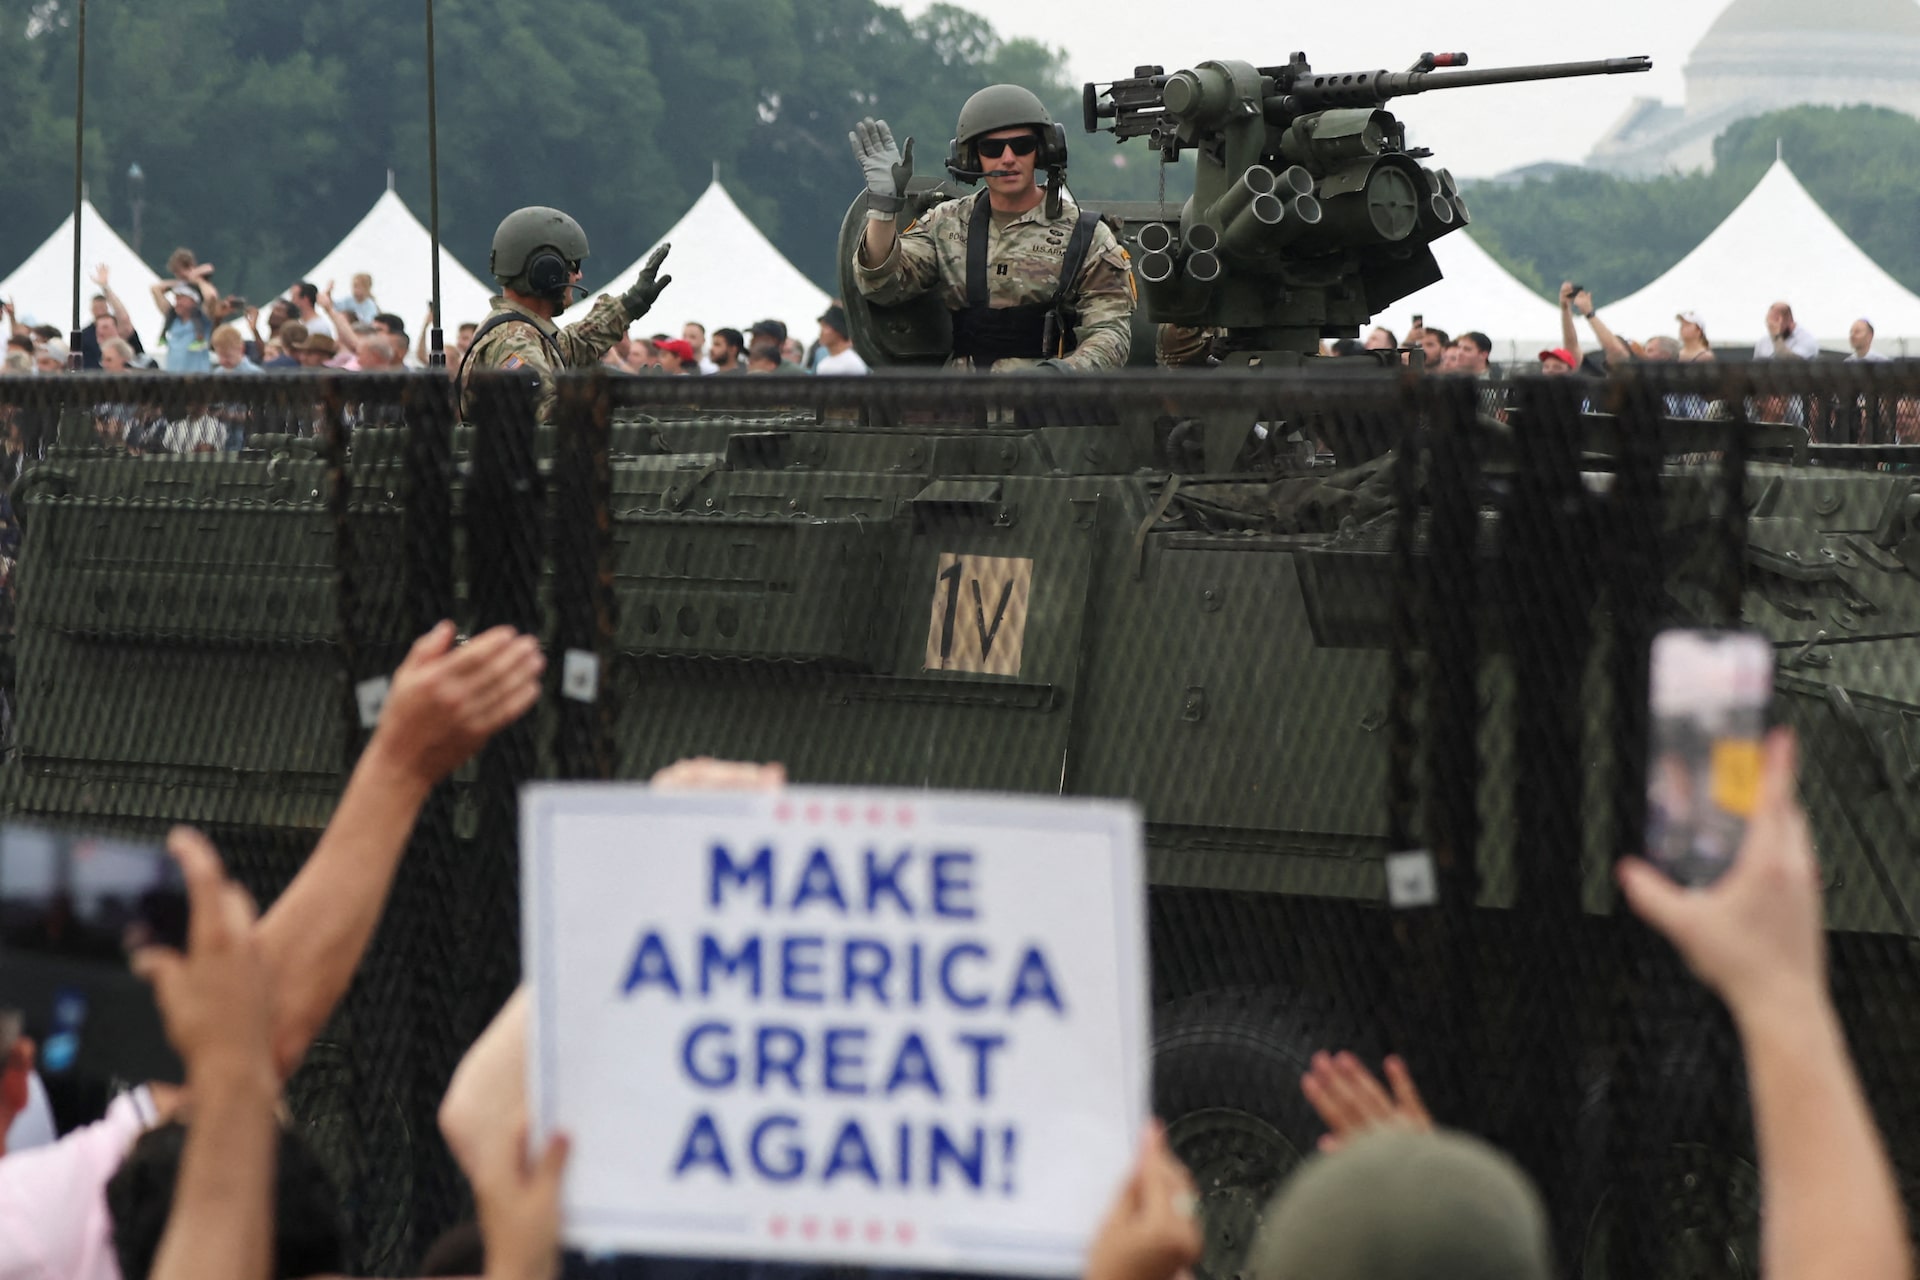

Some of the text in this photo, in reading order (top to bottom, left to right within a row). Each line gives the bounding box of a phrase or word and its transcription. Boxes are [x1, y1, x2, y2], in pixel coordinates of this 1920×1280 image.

[940, 562, 1014, 664] 1V
[709, 843, 976, 919] MAKE
[621, 930, 1065, 1015] AMERICA
[680, 1020, 1007, 1099] GREAT
[673, 1110, 1018, 1196] AGAIN!
